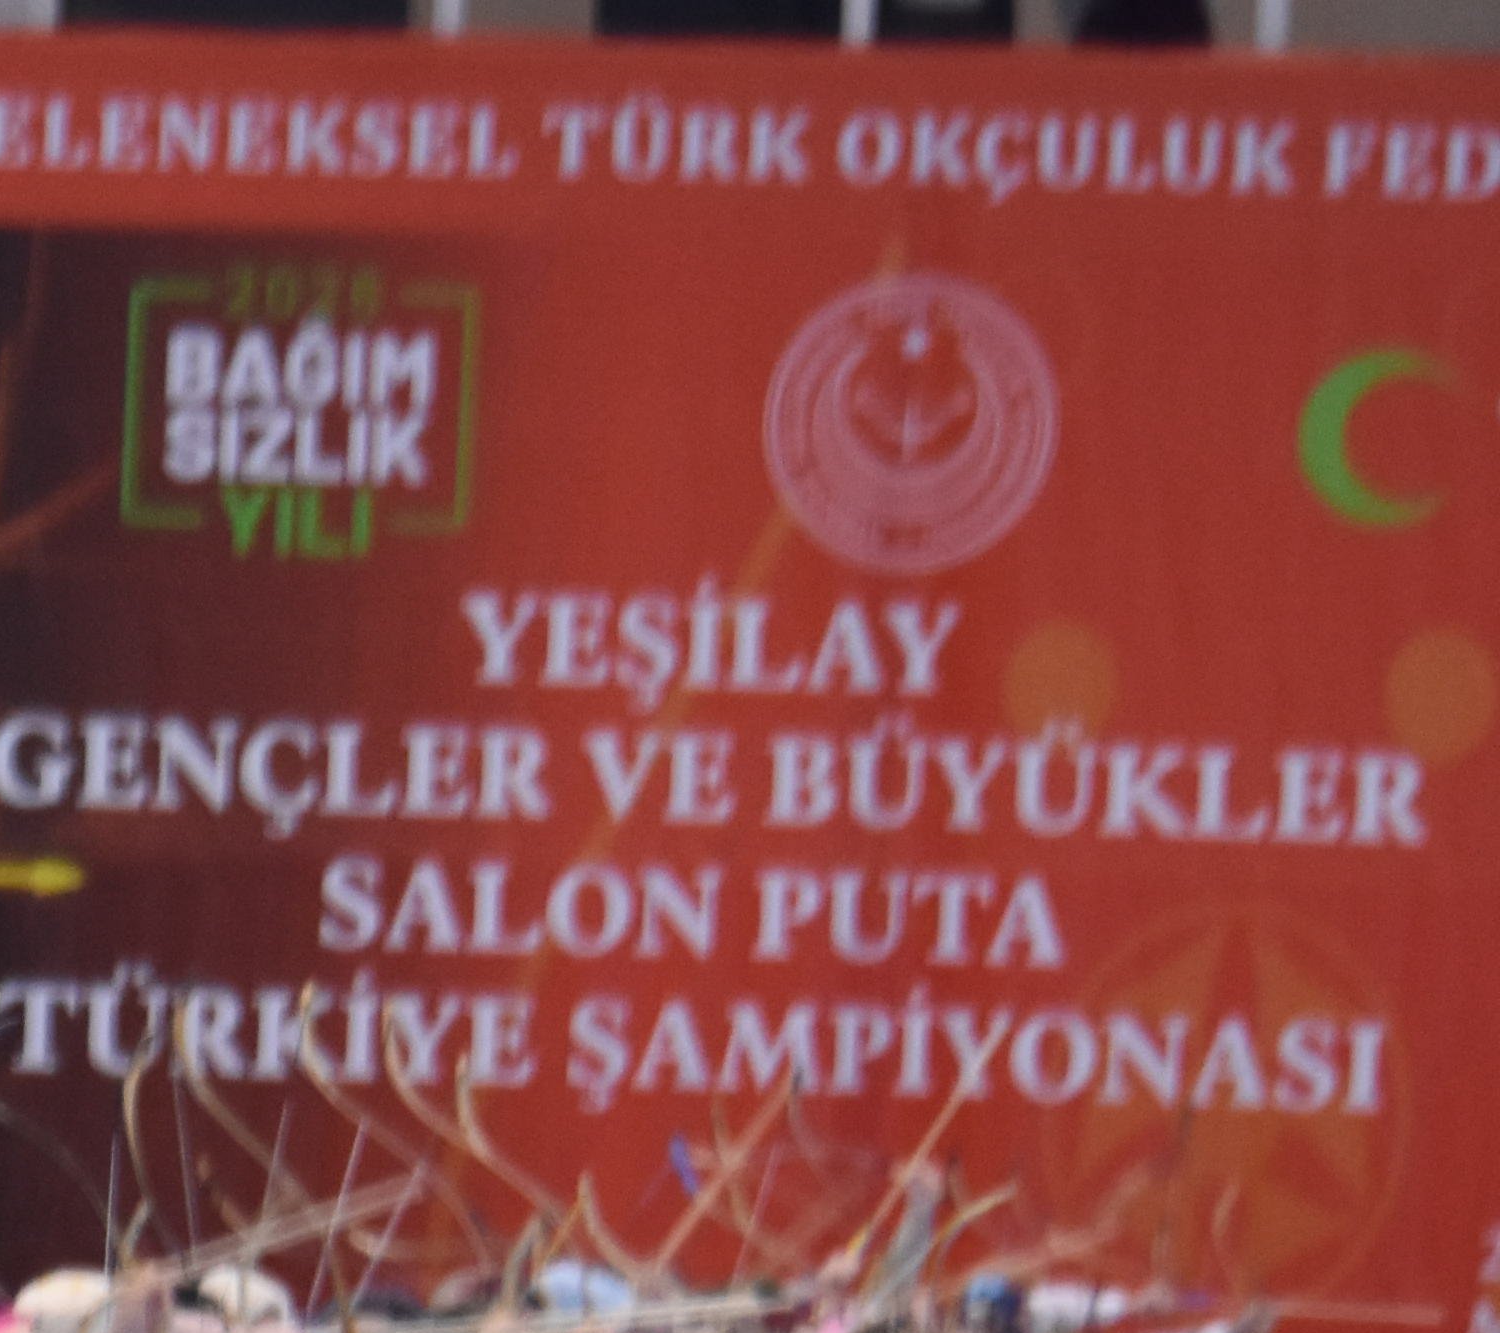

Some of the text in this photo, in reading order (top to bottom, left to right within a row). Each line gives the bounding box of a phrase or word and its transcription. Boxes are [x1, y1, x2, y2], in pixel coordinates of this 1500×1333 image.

[541, 85, 811, 184] TÜRK
[834, 105, 1295, 207] OKÇULUK
[1324, 116, 1500, 199] FED
[164, 316, 438, 409] BAĞIM
[461, 575, 961, 712] YEŞİLAY
[581, 725, 736, 827] VE
[764, 708, 1428, 849] BÜYÜKLER
[318, 854, 1065, 969] SALON PUTA
[565, 979, 1388, 1115] ŞAMPİYONASI
